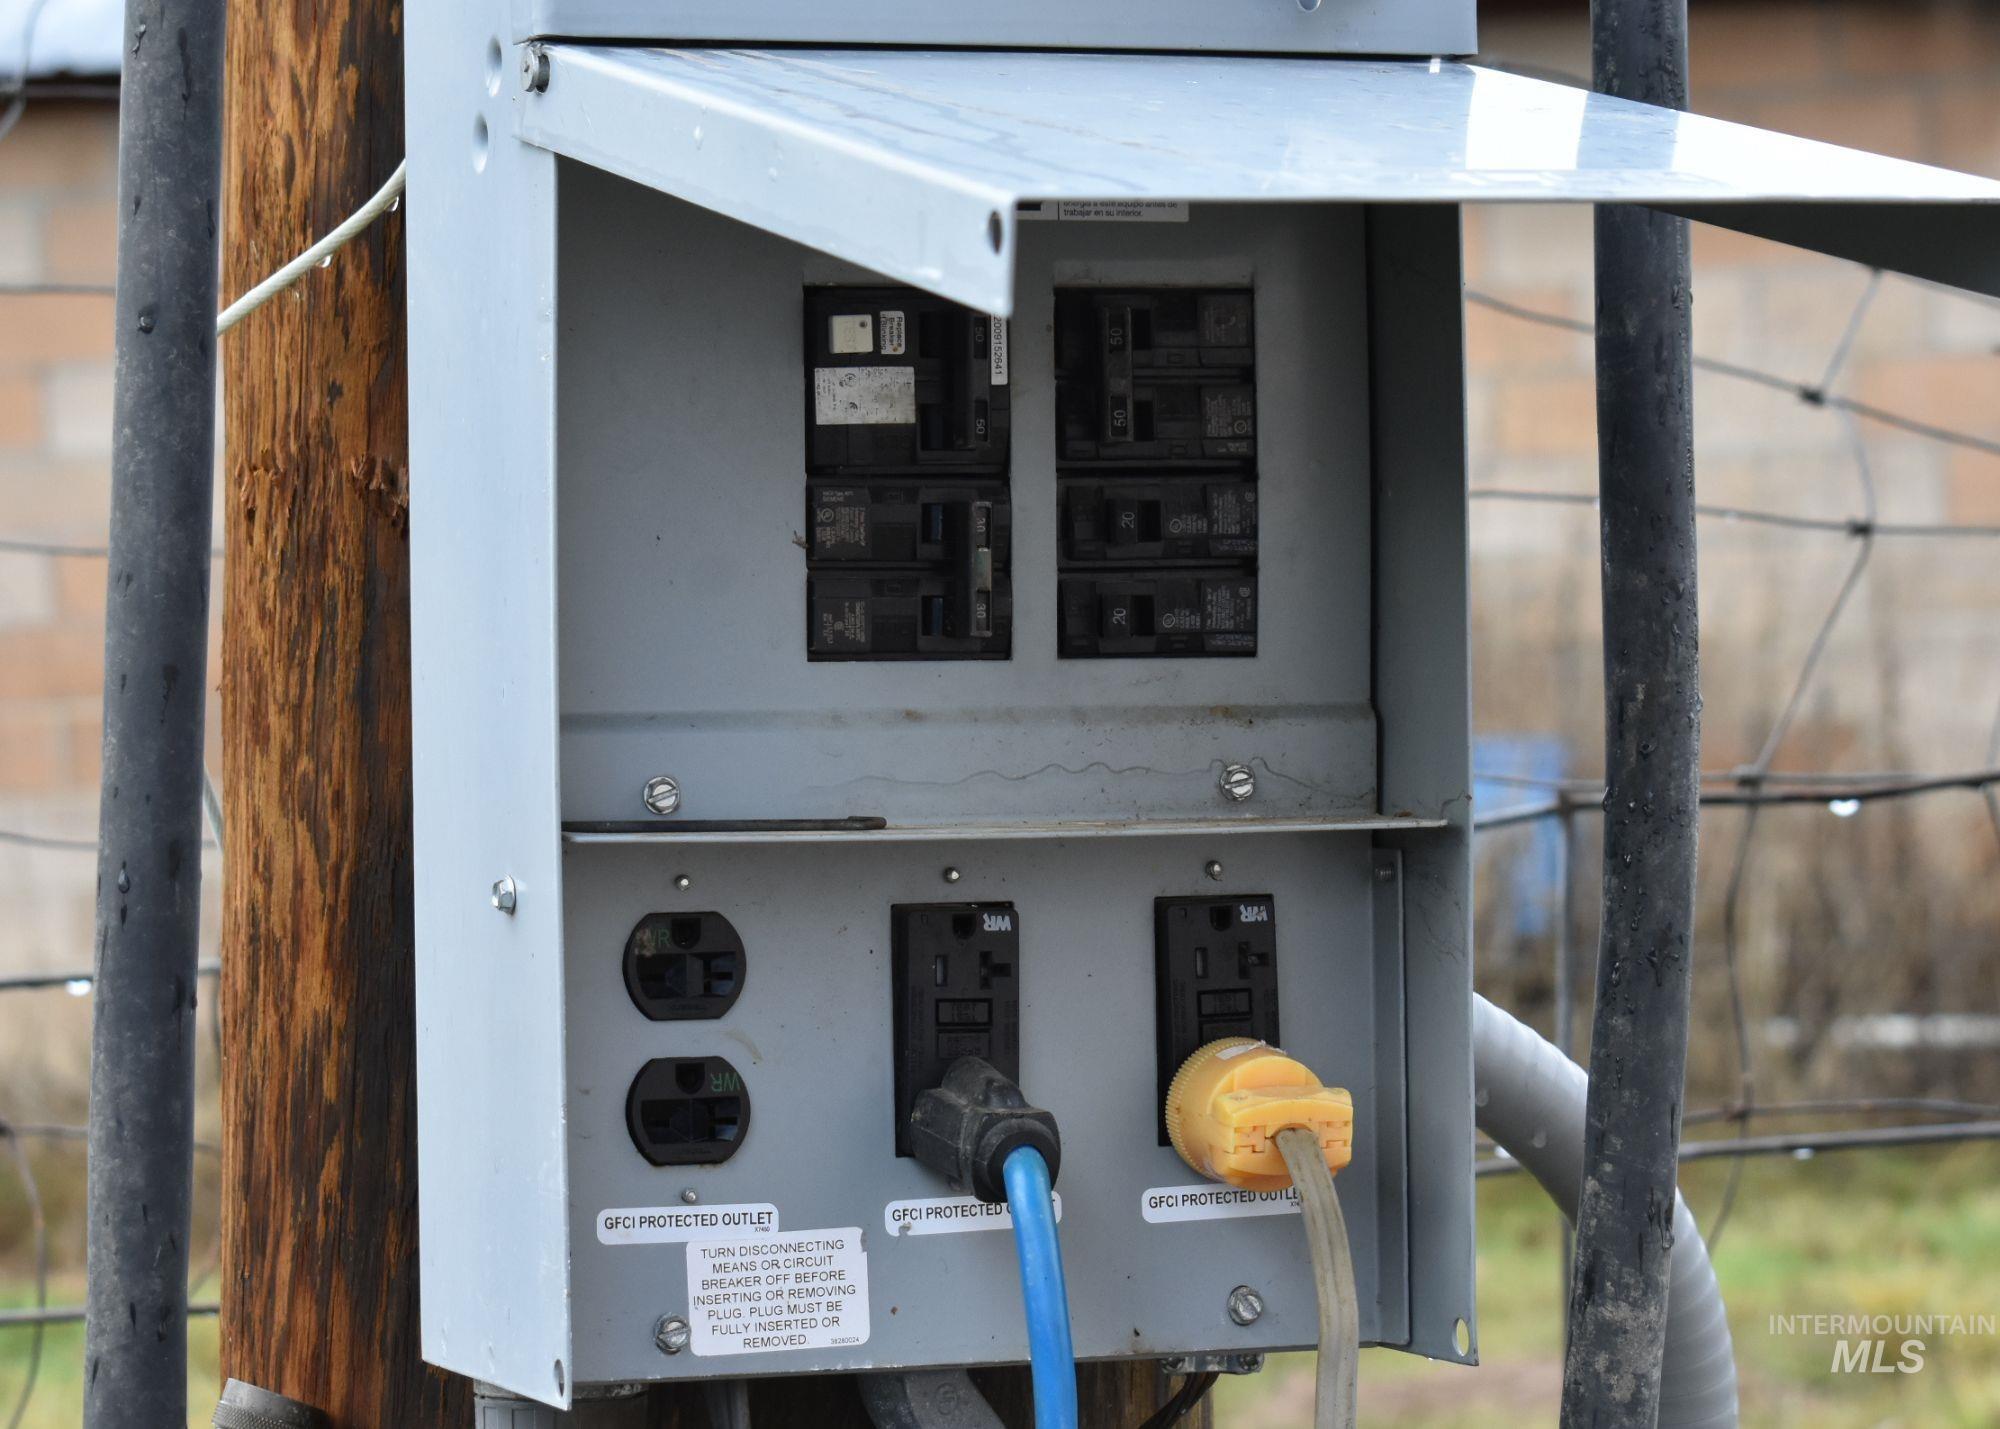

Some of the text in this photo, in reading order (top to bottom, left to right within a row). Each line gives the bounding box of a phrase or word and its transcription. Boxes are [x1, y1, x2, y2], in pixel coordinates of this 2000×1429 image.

[1063, 209, 1093, 218] trabajar
[975, 326, 984, 342] 50
[1110, 328, 1122, 345] 50
[976, 419, 985, 434] 50
[1113, 410, 1126, 427] 50
[1121, 511, 1135, 529] 20
[976, 603, 986, 618] 30
[1113, 607, 1126, 625] 20
[983, 912, 1011, 931] WR
[1239, 904, 1268, 922] WR
[710, 1072, 741, 1092] WR
[1148, 1195, 1178, 1209] GFCI
[1181, 1191, 1256, 1207] PROTECTED
[604, 1211, 774, 1230] GFCI PROTECTED OUTLET
[892, 1208, 923, 1222] GFCI
[926, 1203, 1003, 1219] PROTECTED
[702, 1239, 845, 1259] TURN DISCONNECTING
[712, 1255, 835, 1274] MEANS OR CIRCUIT
[701, 1270, 846, 1290] BREAKER OFF BEFORE
[693, 1285, 856, 1306] INSERTING OR REMOVING
[750, 1305, 783, 1317] PLUG
[787, 1302, 823, 1315] MUST
[826, 1301, 843, 1312] BE
[711, 1316, 840, 1335] FULLY INSERTED OR
[743, 1334, 810, 1348] REMOVED.
